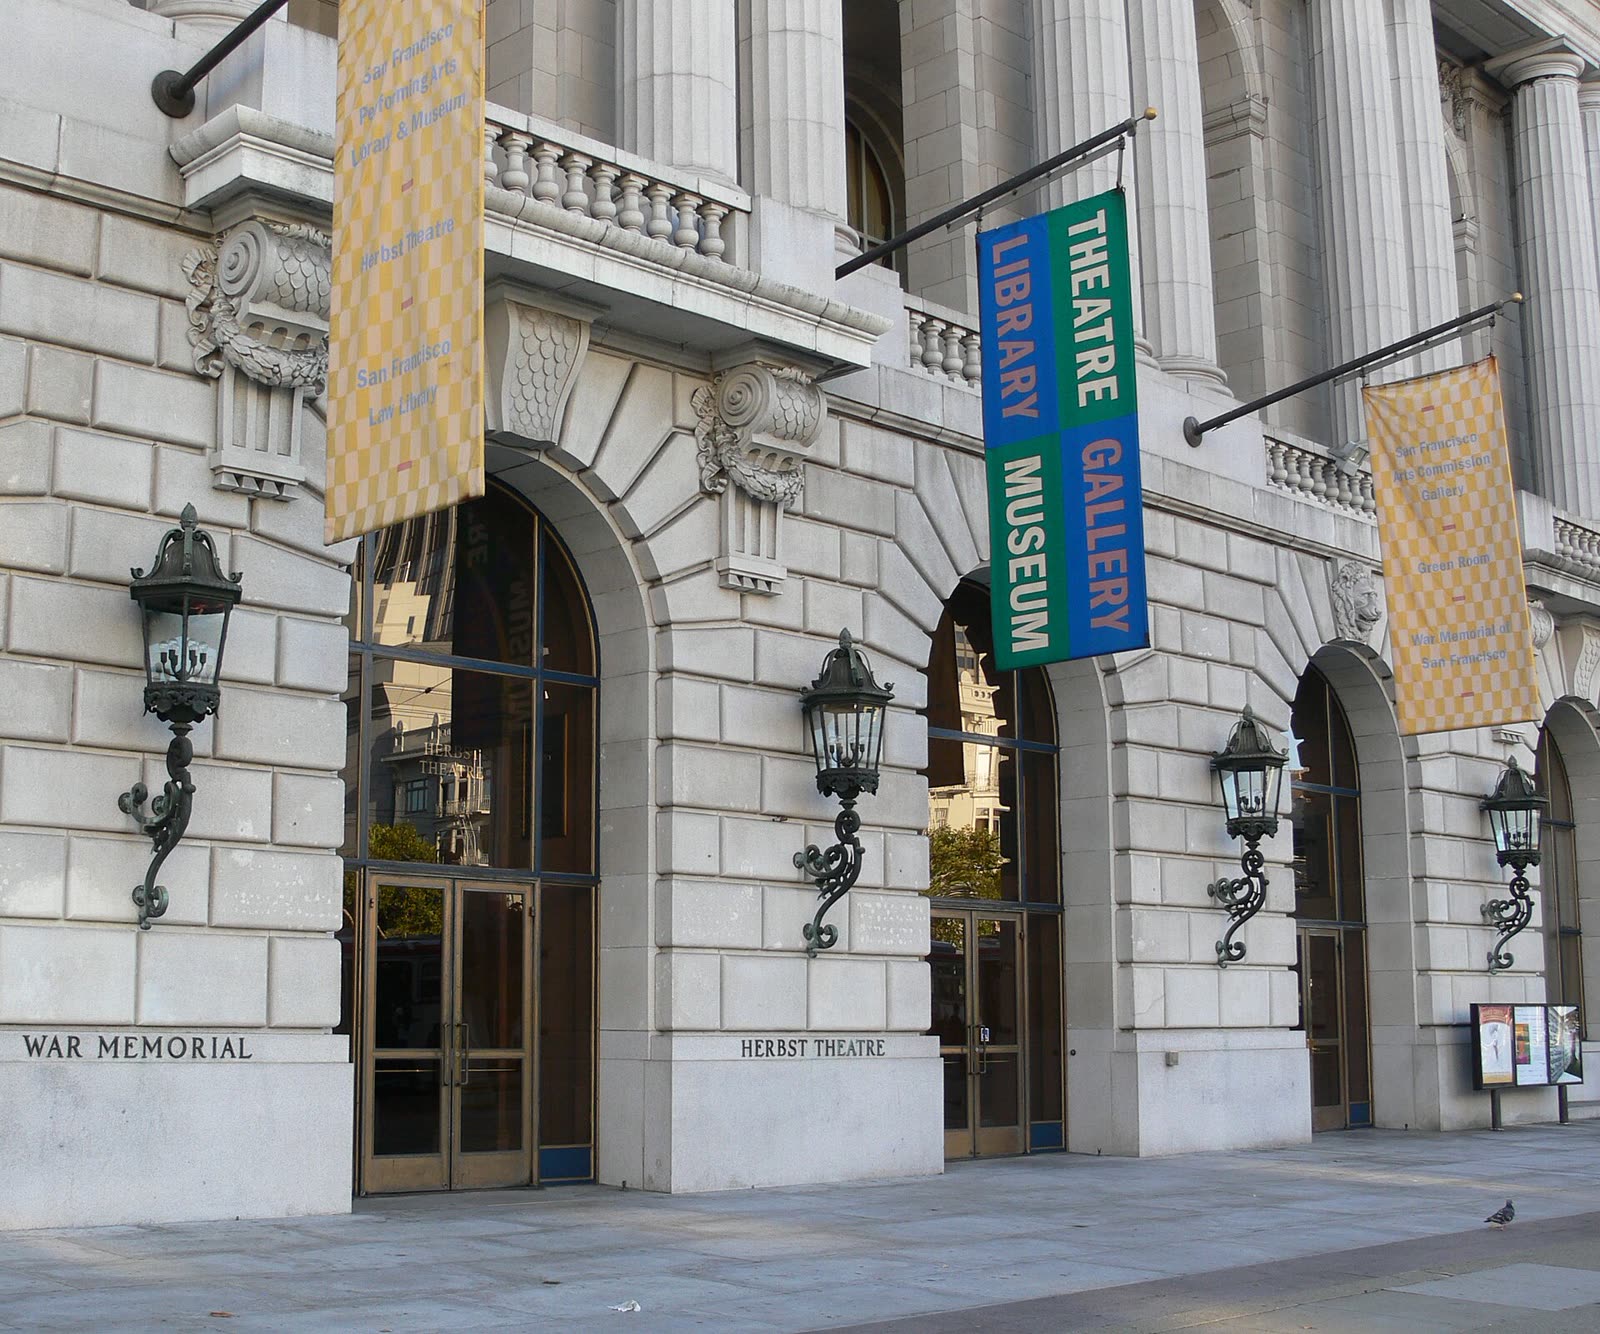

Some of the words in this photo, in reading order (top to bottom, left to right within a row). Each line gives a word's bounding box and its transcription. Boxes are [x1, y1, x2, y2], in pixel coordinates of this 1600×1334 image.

[363, 59, 388, 84] San
[392, 24, 454, 68] Francisco
[359, 72, 429, 126] Performing
[431, 58, 458, 83] Arts
[397, 121, 409, 140] &
[412, 91, 467, 133] Museum
[360, 238, 404, 273] Herbst
[406, 217, 455, 253] Theatre
[1067, 208, 1119, 408] THEATRE
[991, 234, 1040, 419] LIBRARY
[357, 367, 388, 389] San
[392, 339, 451, 380] Francisco
[369, 404, 395, 427] Law
[399, 384, 438, 416] Library
[1395, 445, 1416, 459] San
[1420, 433, 1478, 455] Francisco
[1393, 469, 1416, 483] Arts
[1417, 454, 1491, 478] Commission
[1421, 484, 1464, 502] Gallery
[1080, 437, 1130, 633] GALLERY
[1003, 454, 1050, 654] MUSEUM
[1417, 560, 1455, 574] Green
[1458, 553, 1491, 569] Room
[1411, 633, 1436, 647] War
[1440, 623, 1496, 644] Memorial
[1500, 621, 1512, 635] of
[1422, 656, 1446, 669] San
[1449, 648, 1508, 666] Francisco
[424, 742, 476, 760] HERBS
[419, 760, 484, 780] THEATRE
[22, 1034, 83, 1059] WAR
[96, 1035, 254, 1059] MEMORIAL
[740, 1038, 808, 1058] HERBST
[813, 1038, 886, 1058] THEATRE
